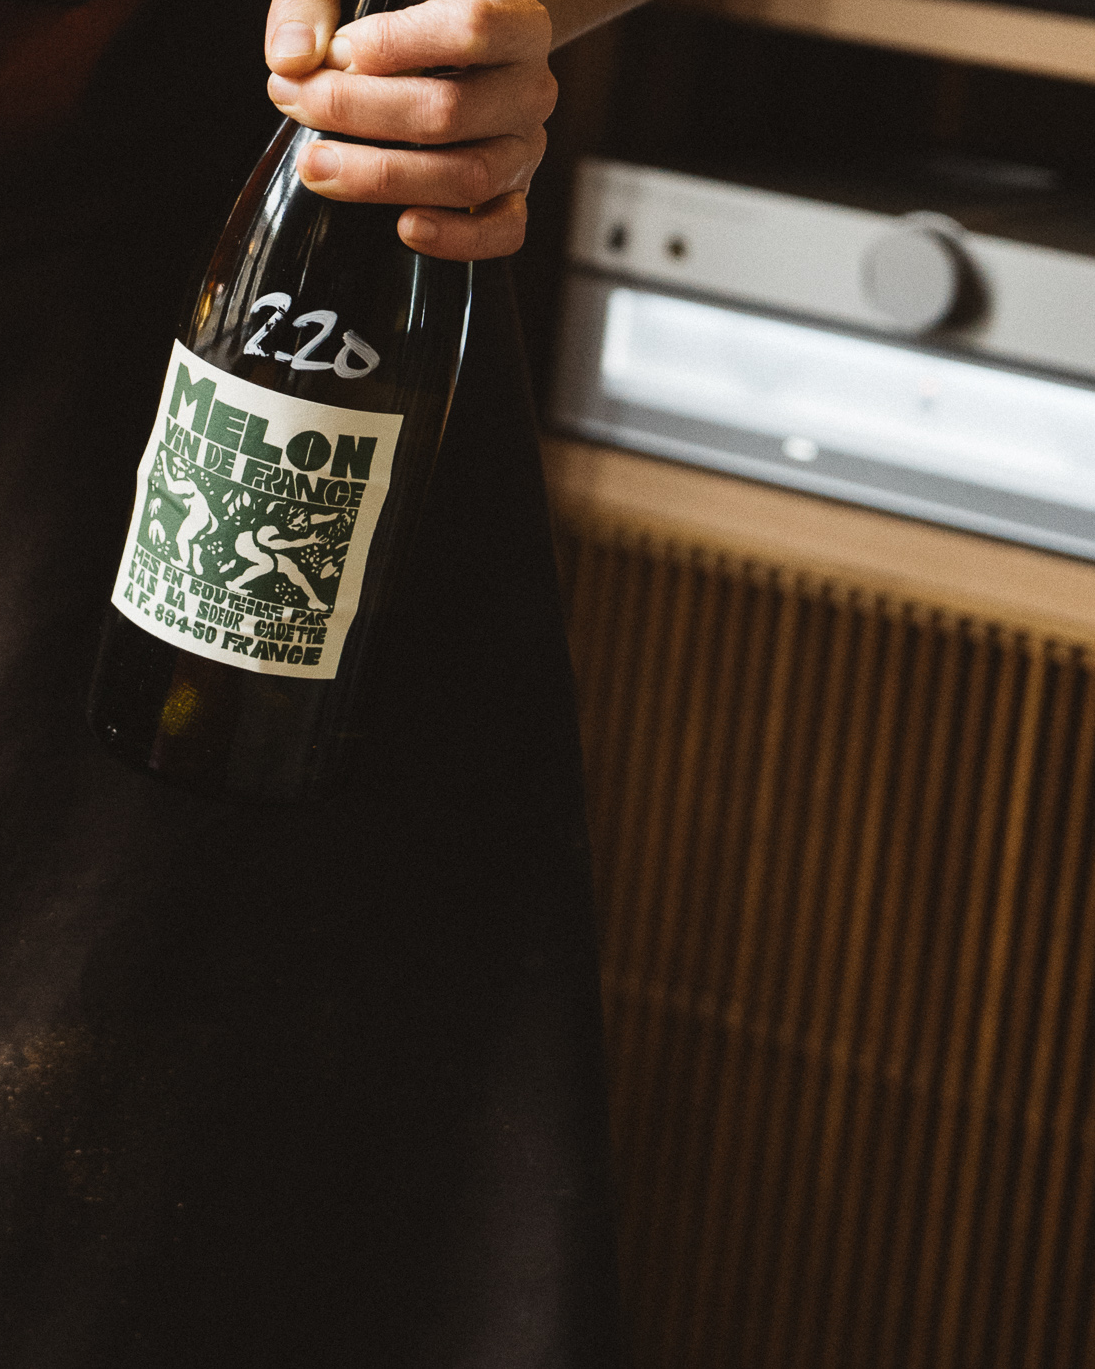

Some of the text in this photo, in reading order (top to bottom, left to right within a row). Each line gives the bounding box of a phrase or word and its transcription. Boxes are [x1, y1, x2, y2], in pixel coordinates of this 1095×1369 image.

[244, 292, 381, 379] 220
[168, 361, 378, 481] MELON
[203, 440, 238, 479] DE
[240, 457, 367, 509] FRANCE
[128, 559, 158, 596] SAS
[164, 584, 186, 613] LA
[253, 619, 328, 645] CADETTE
[162, 564, 185, 589] EN
[289, 609, 331, 627] PAR
[220, 630, 323, 666] FRANCE
